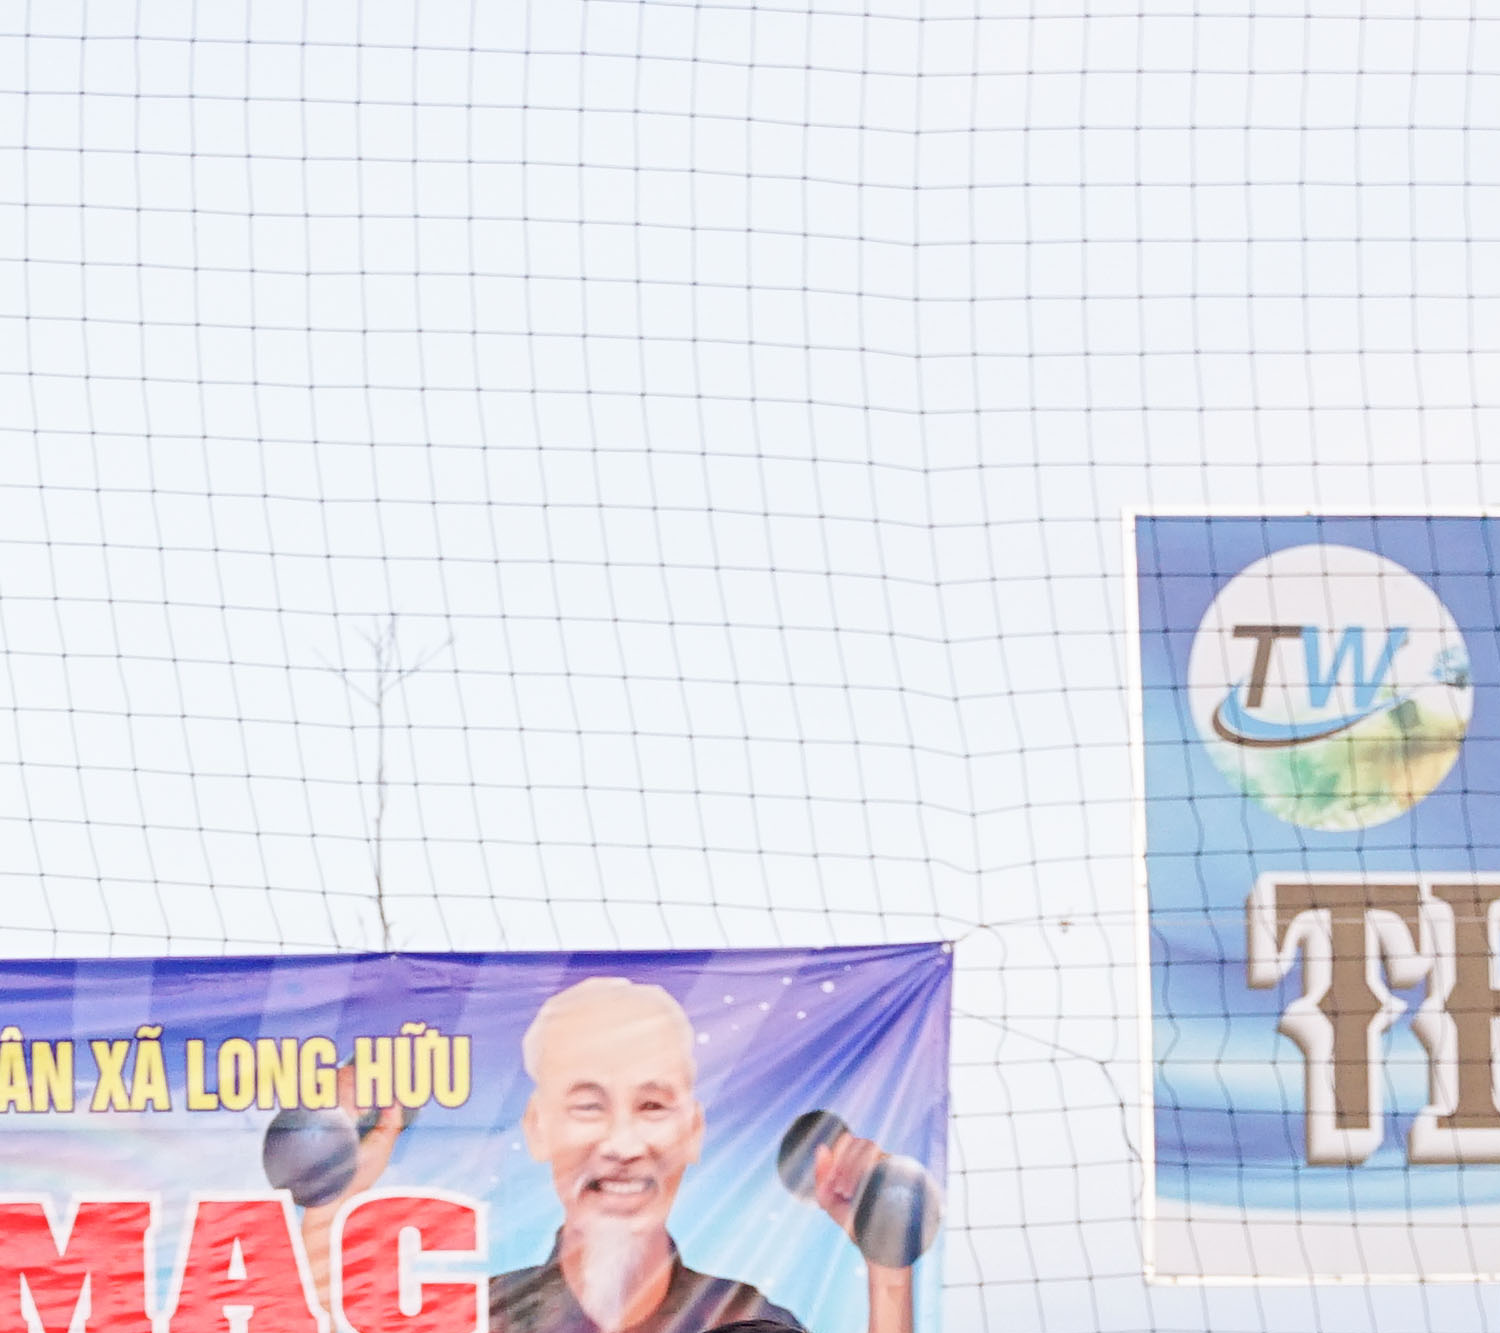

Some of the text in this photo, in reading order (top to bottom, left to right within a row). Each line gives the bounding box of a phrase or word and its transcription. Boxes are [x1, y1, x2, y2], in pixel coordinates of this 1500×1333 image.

[1232, 625, 1408, 708] TW
[90, 1024, 171, 1113] XÃ
[186, 1037, 339, 1111] LONG
[355, 1021, 471, 1109] HỮU
